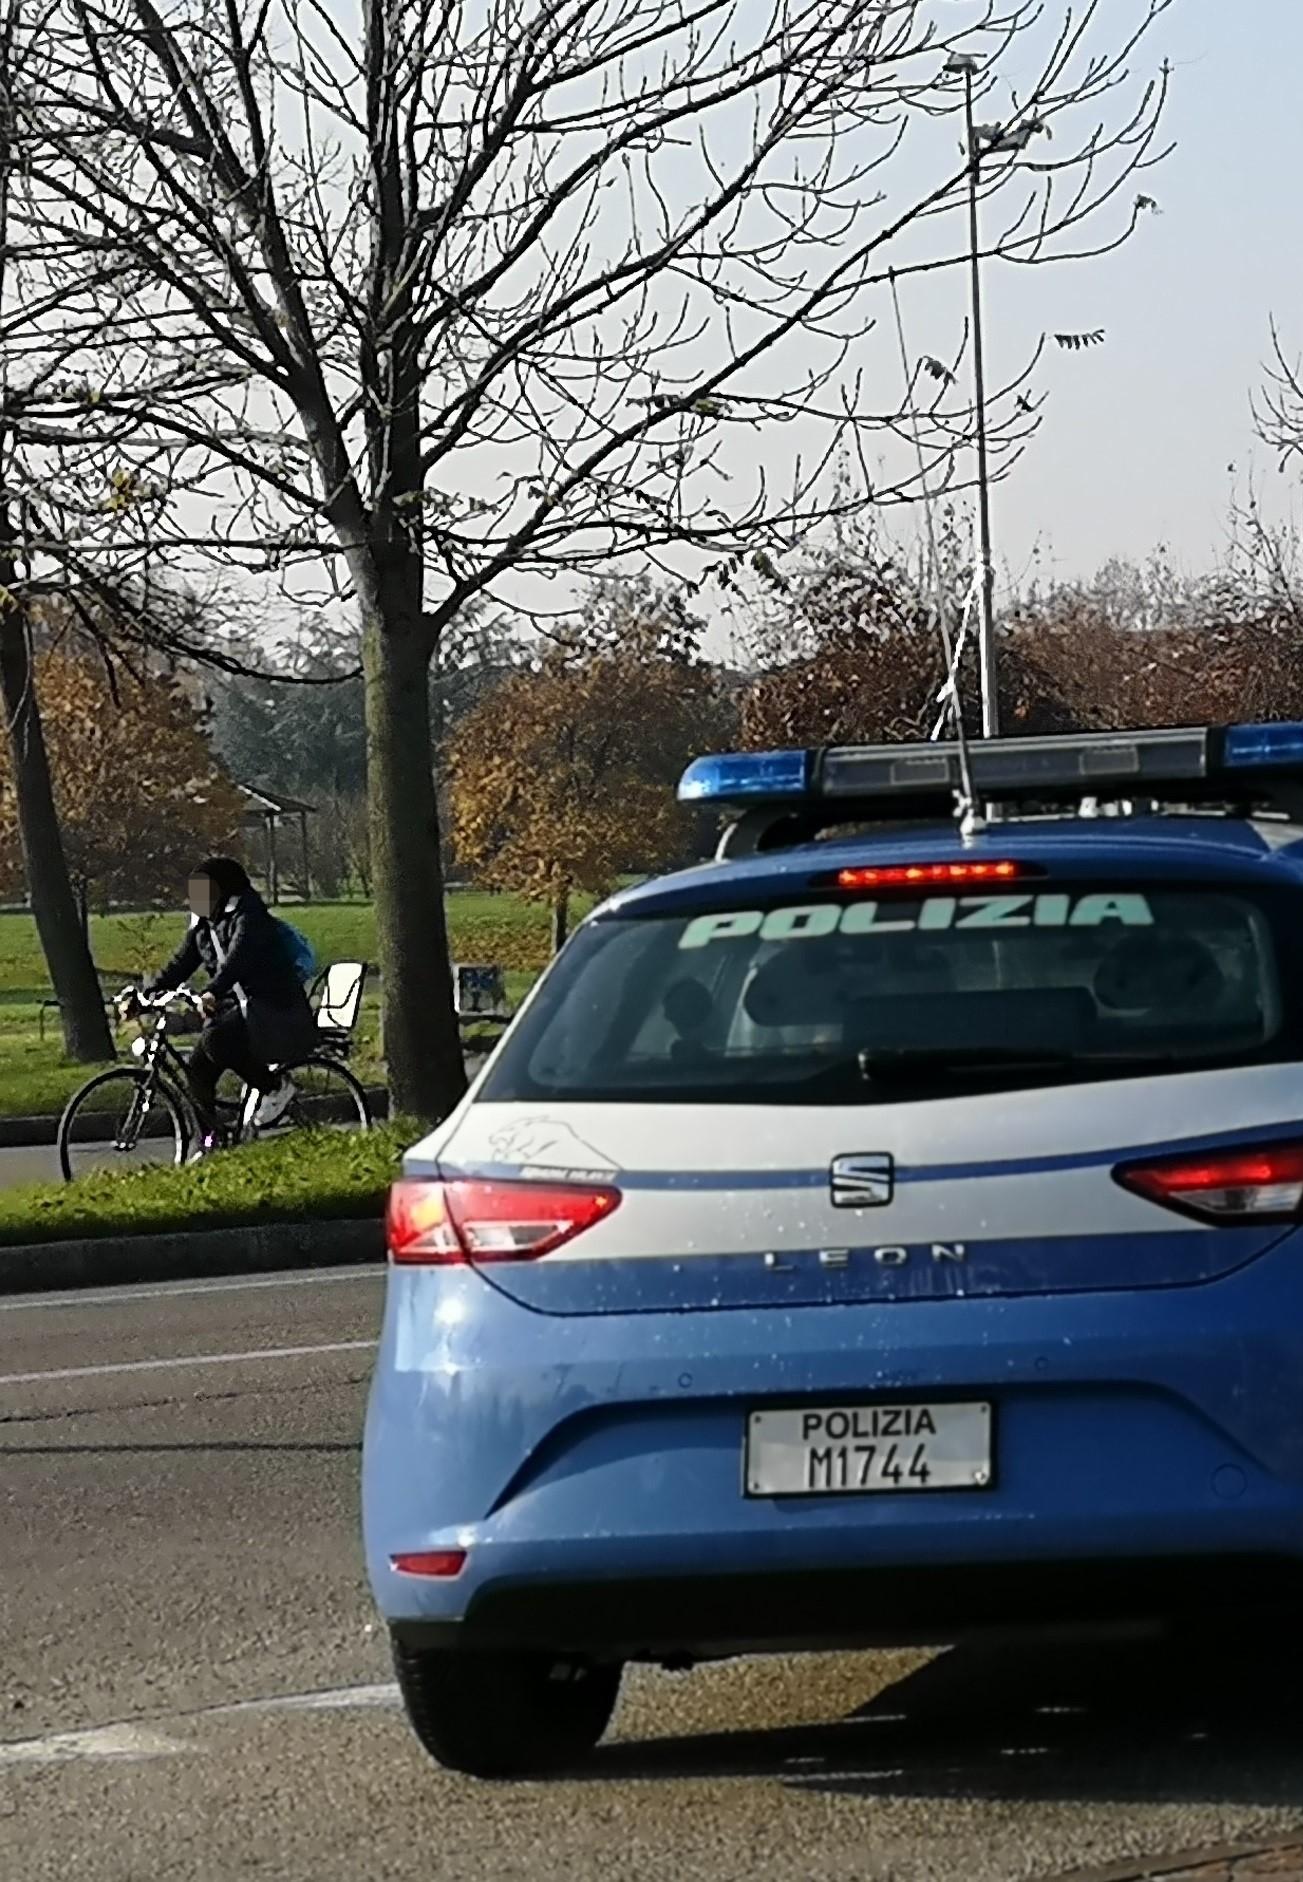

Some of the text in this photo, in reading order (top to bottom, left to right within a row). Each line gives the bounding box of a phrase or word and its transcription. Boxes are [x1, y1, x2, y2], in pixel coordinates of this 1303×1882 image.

[678, 893, 1155, 950] POLIZIA
[764, 1243, 966, 1270] LEON
[802, 1408, 937, 1441] POLIZIA
[808, 1442, 931, 1489] M1744
